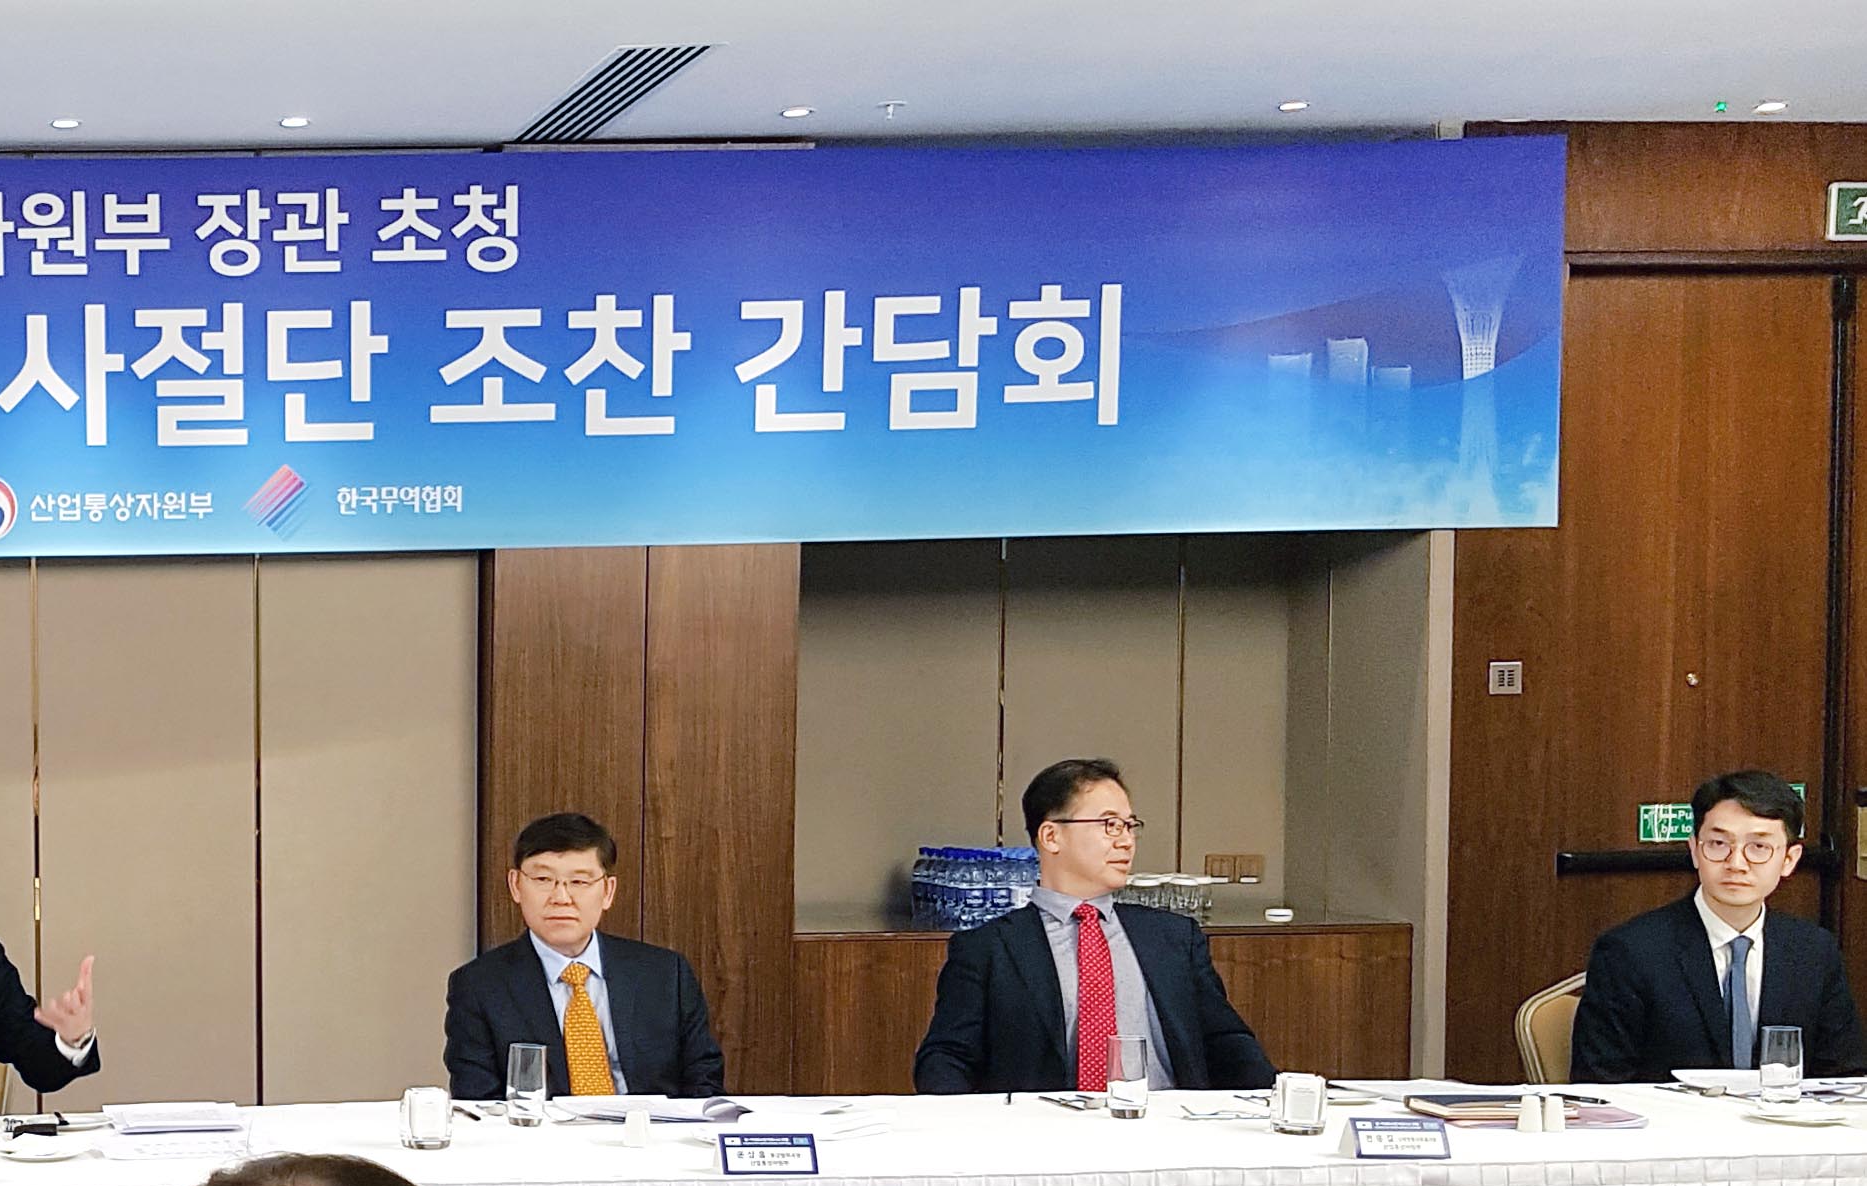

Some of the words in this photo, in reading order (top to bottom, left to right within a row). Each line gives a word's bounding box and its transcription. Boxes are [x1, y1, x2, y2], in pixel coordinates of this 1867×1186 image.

[196, 188, 349, 276] 장관
[373, 185, 519, 271] 초청
[430, 295, 691, 436] 조찬
[735, 284, 1122, 432] 간담회
[30, 492, 214, 522] 산업통상자원부
[337, 486, 464, 514] 한국무역협회
[1677, 811, 1694, 821] Pu
